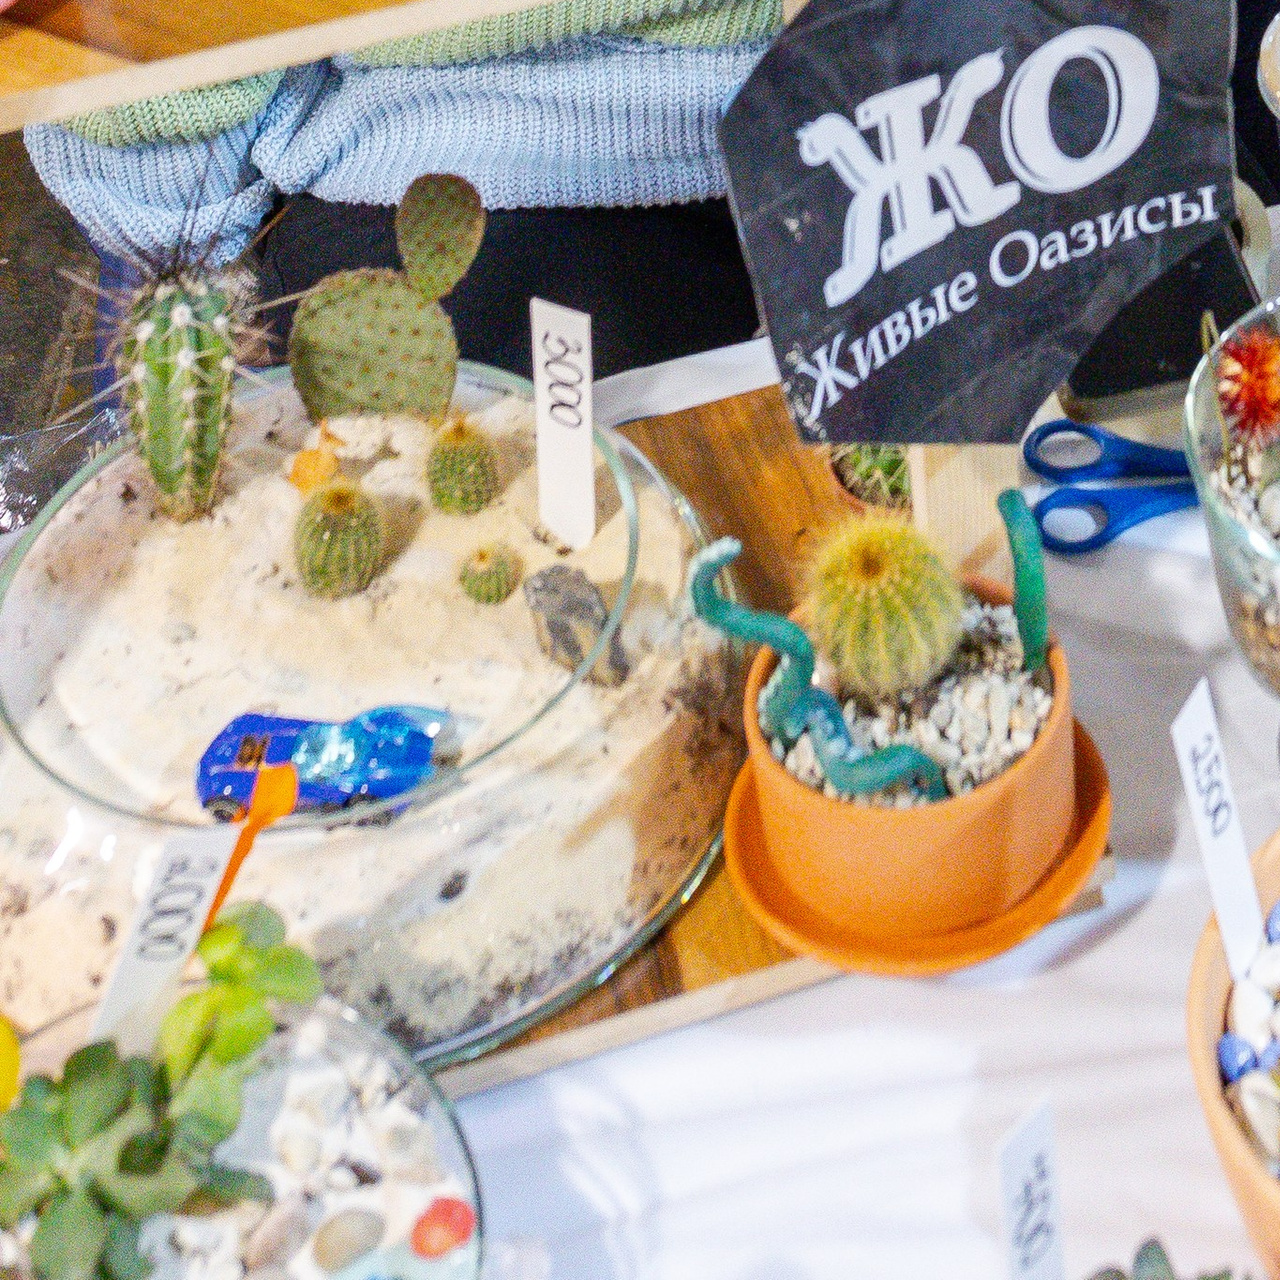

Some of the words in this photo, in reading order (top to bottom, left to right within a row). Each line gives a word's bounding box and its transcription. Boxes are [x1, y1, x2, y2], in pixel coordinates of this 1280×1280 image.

[797, 24, 1160, 308] ЖО
[543, 330, 583, 429] 3000
[796, 271, 979, 420] Живые
[989, 184, 1220, 288] Оазисы
[1190, 733, 1232, 838] 2500
